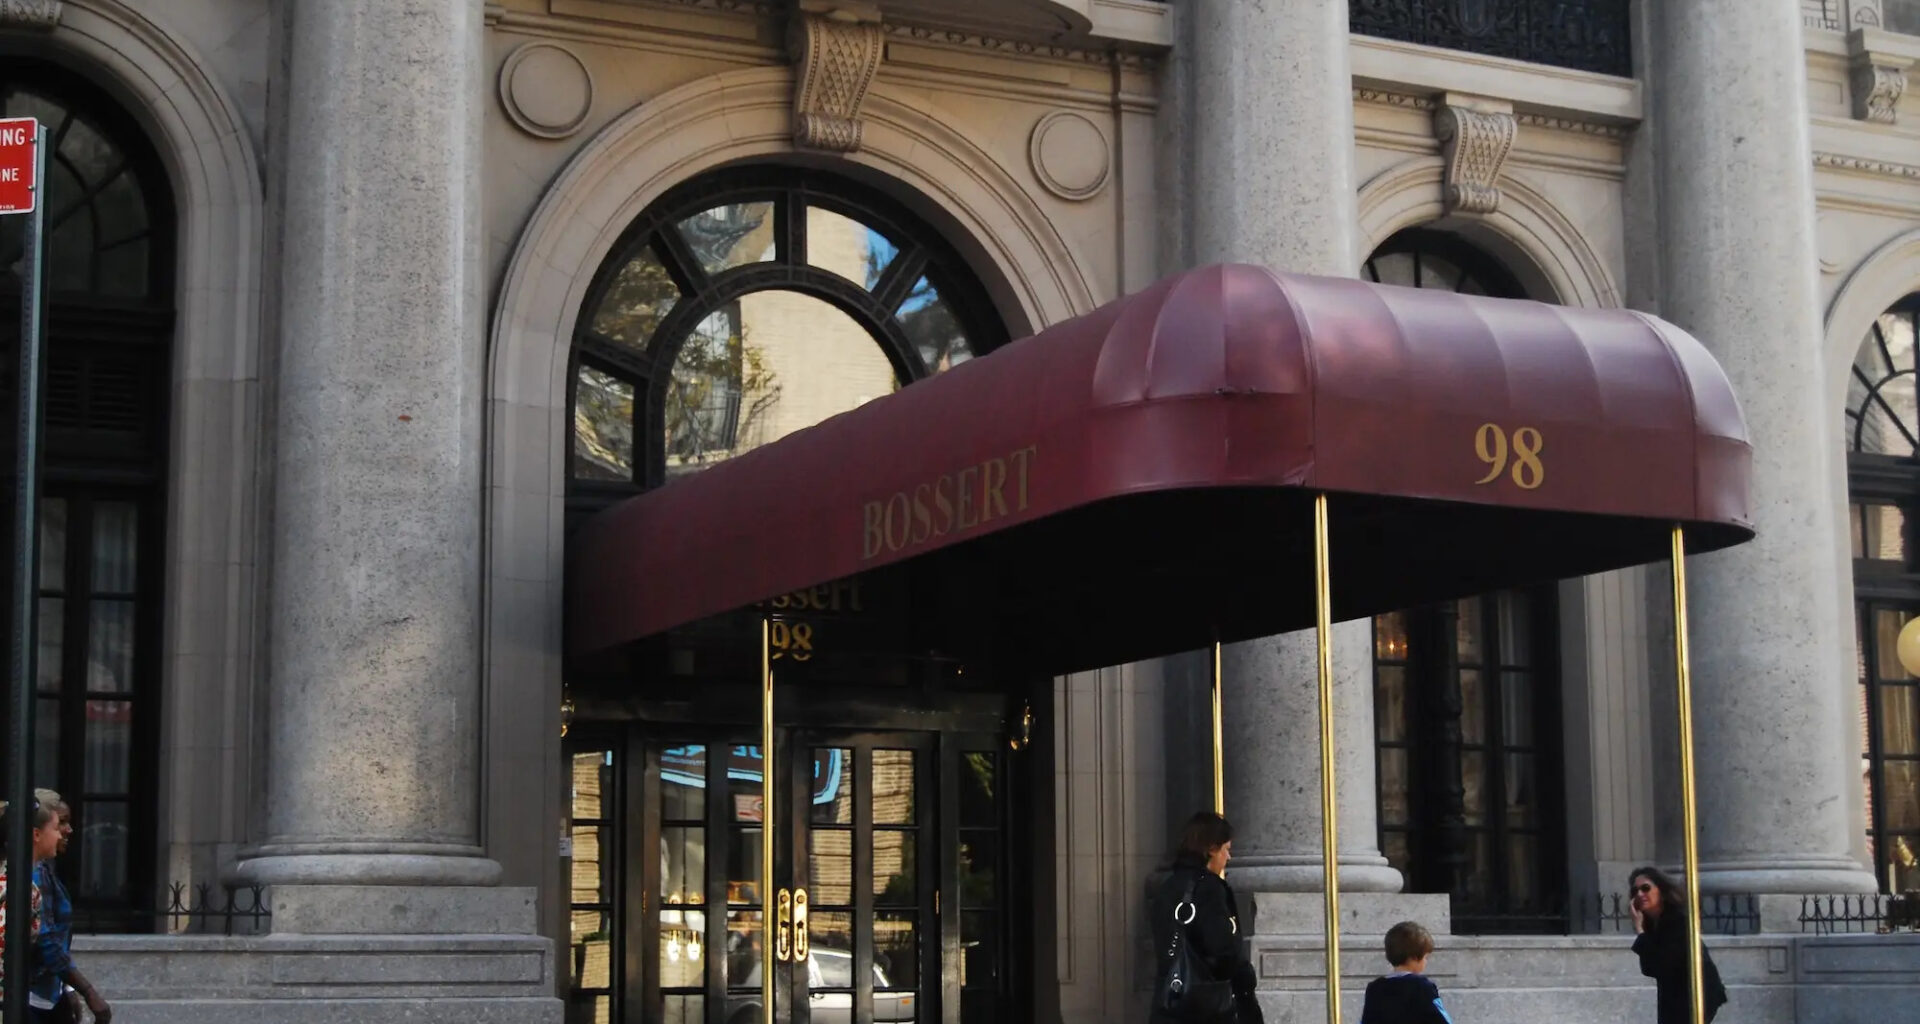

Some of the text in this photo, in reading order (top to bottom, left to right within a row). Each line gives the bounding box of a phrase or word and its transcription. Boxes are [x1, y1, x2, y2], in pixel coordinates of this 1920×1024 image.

[0, 167, 19, 182] NE
[1475, 422, 1544, 489] 98
[862, 444, 1037, 560] BOSSERT
[771, 621, 813, 661] 98
